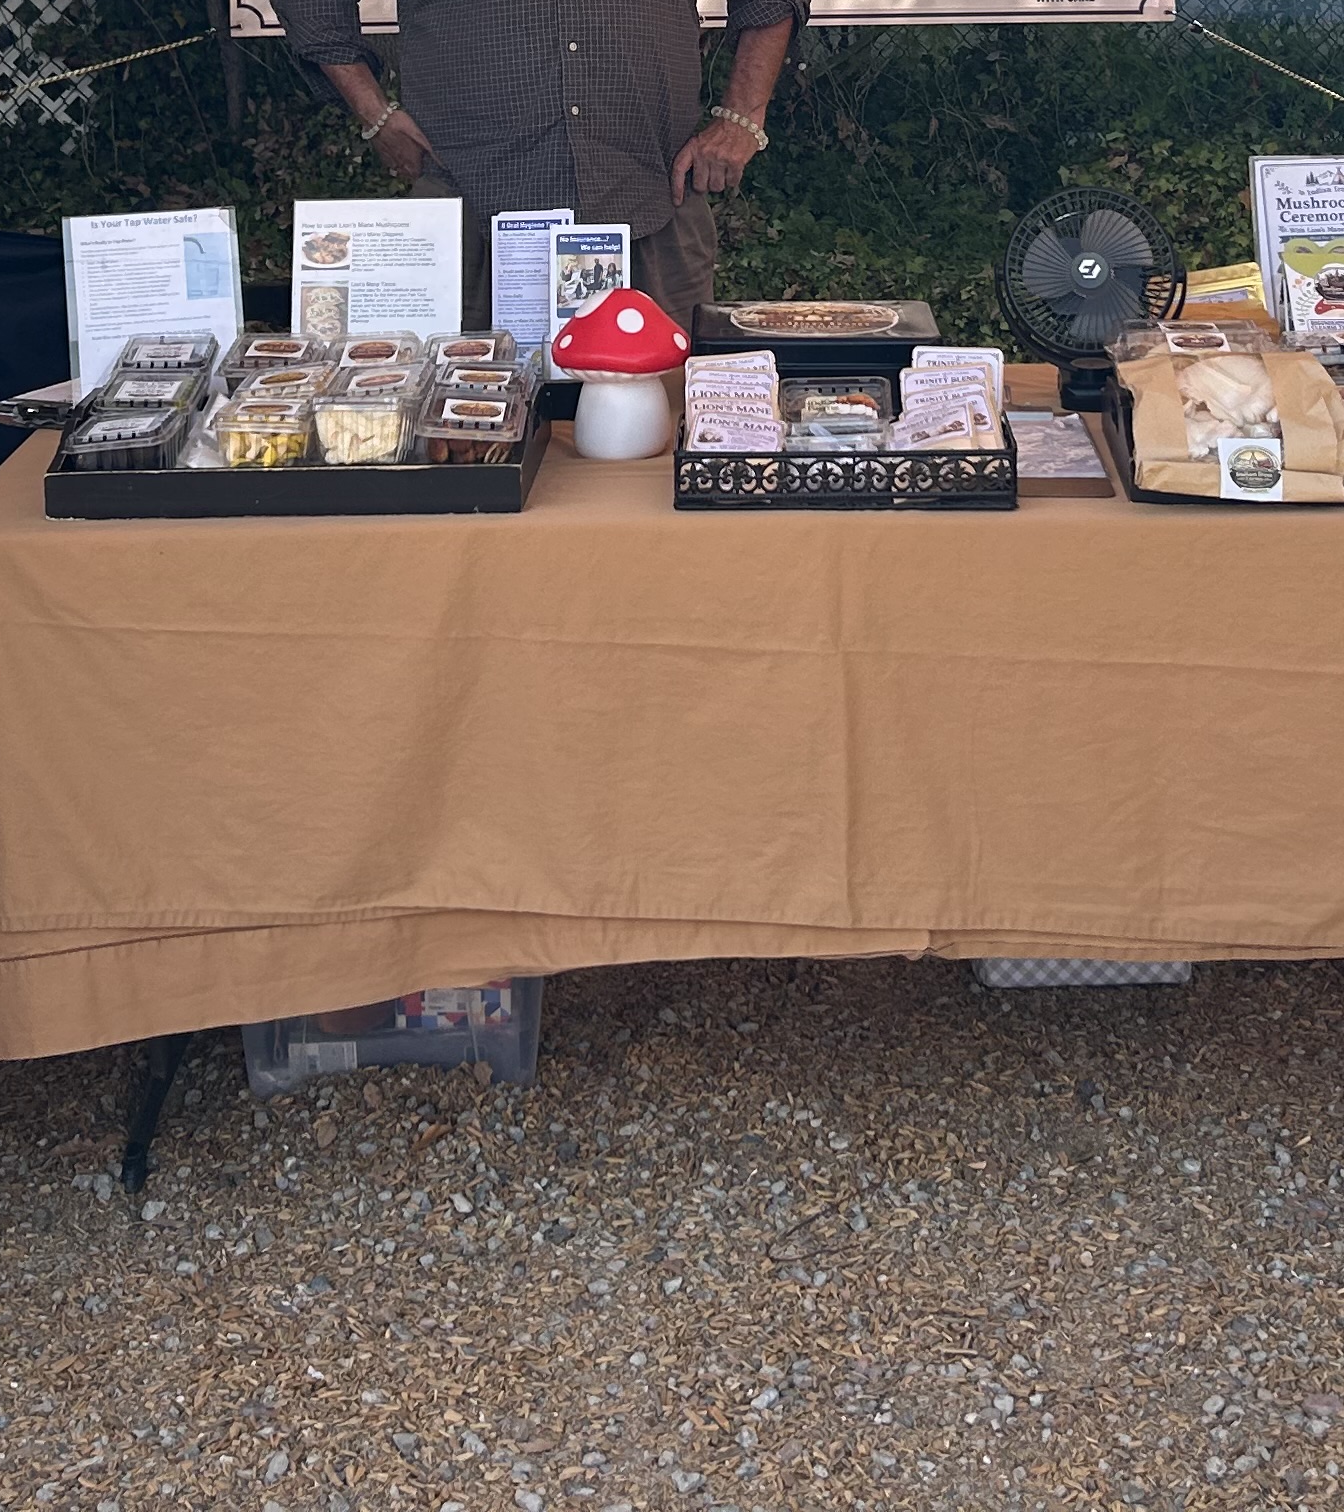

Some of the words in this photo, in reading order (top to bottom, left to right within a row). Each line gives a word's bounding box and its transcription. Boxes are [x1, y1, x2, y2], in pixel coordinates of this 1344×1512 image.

[124, 219, 141, 227] Tap
[143, 217, 171, 225] Water
[174, 214, 197, 223] Safe?
[737, 406, 771, 415] MANE
